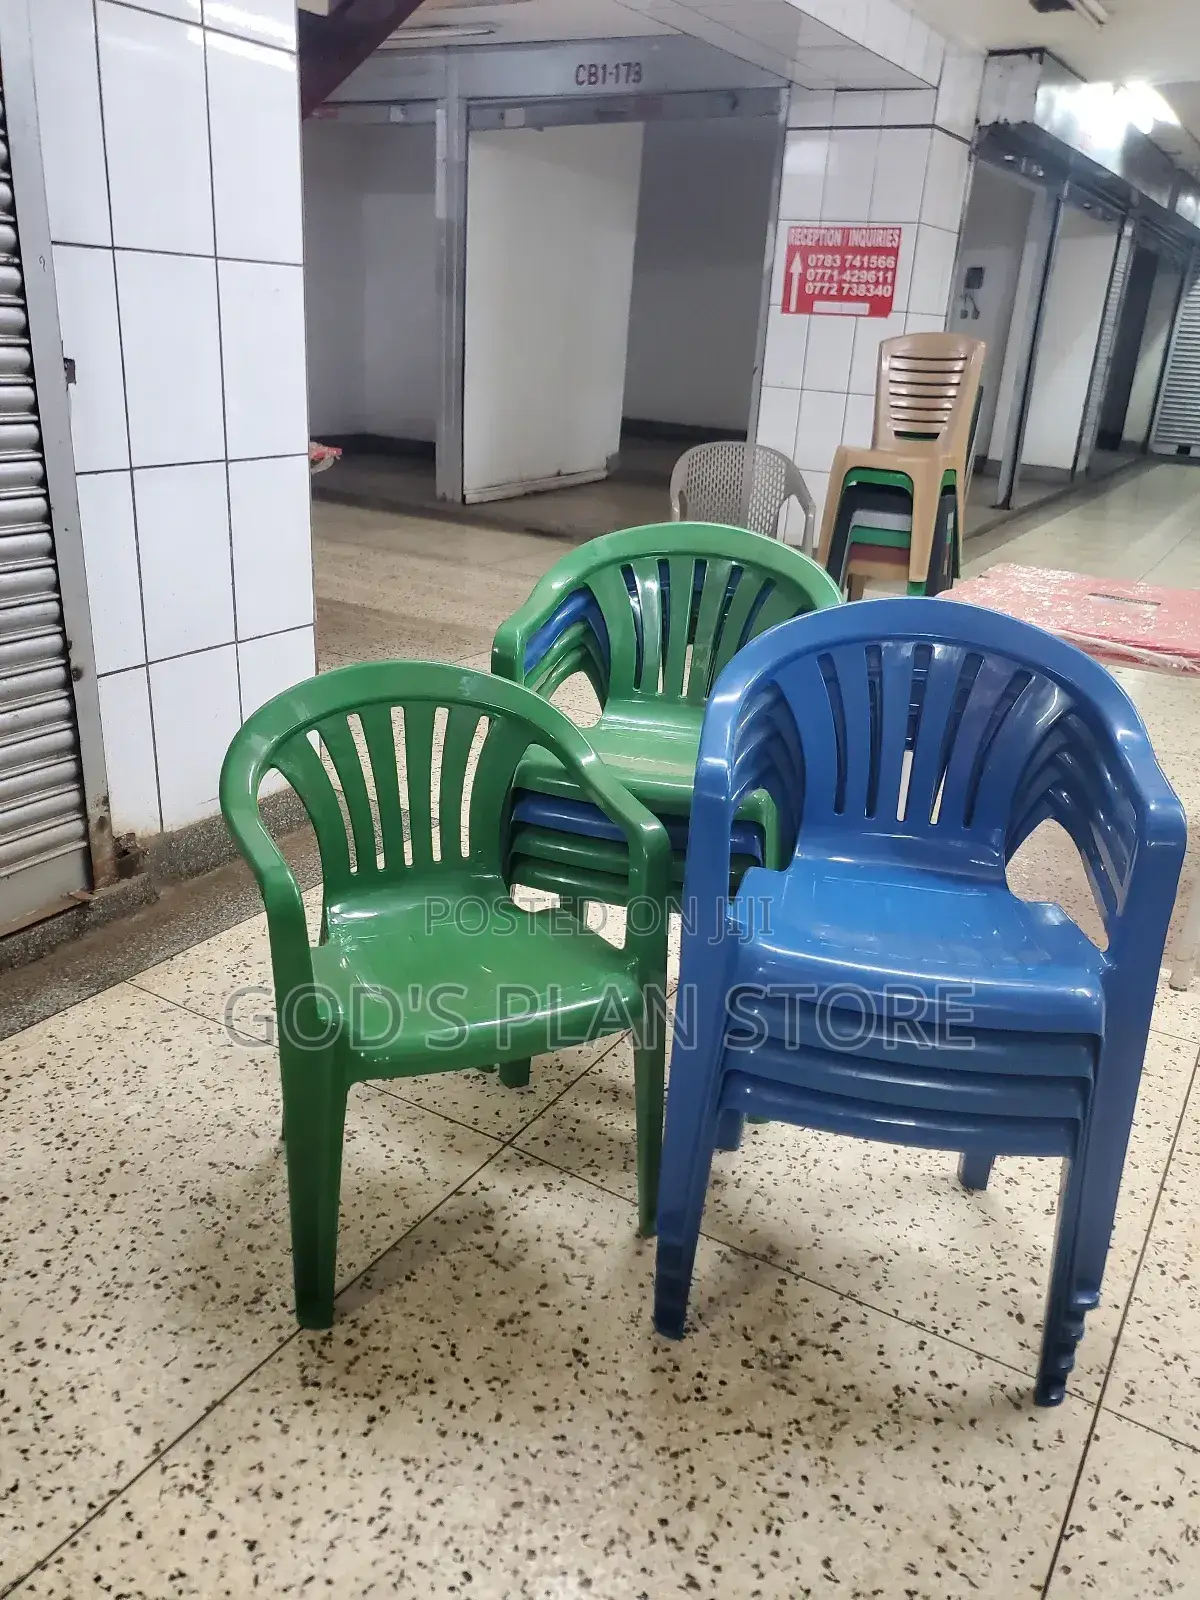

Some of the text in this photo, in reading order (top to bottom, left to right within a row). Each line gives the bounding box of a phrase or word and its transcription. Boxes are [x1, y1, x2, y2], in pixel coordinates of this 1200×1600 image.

[575, 62, 642, 85] CB1-173
[788, 228, 842, 247] RECEPTION
[848, 229, 900, 248] INQUIRIES
[807, 254, 896, 269] 0783 741566
[804, 282, 892, 297] 0772 738340
